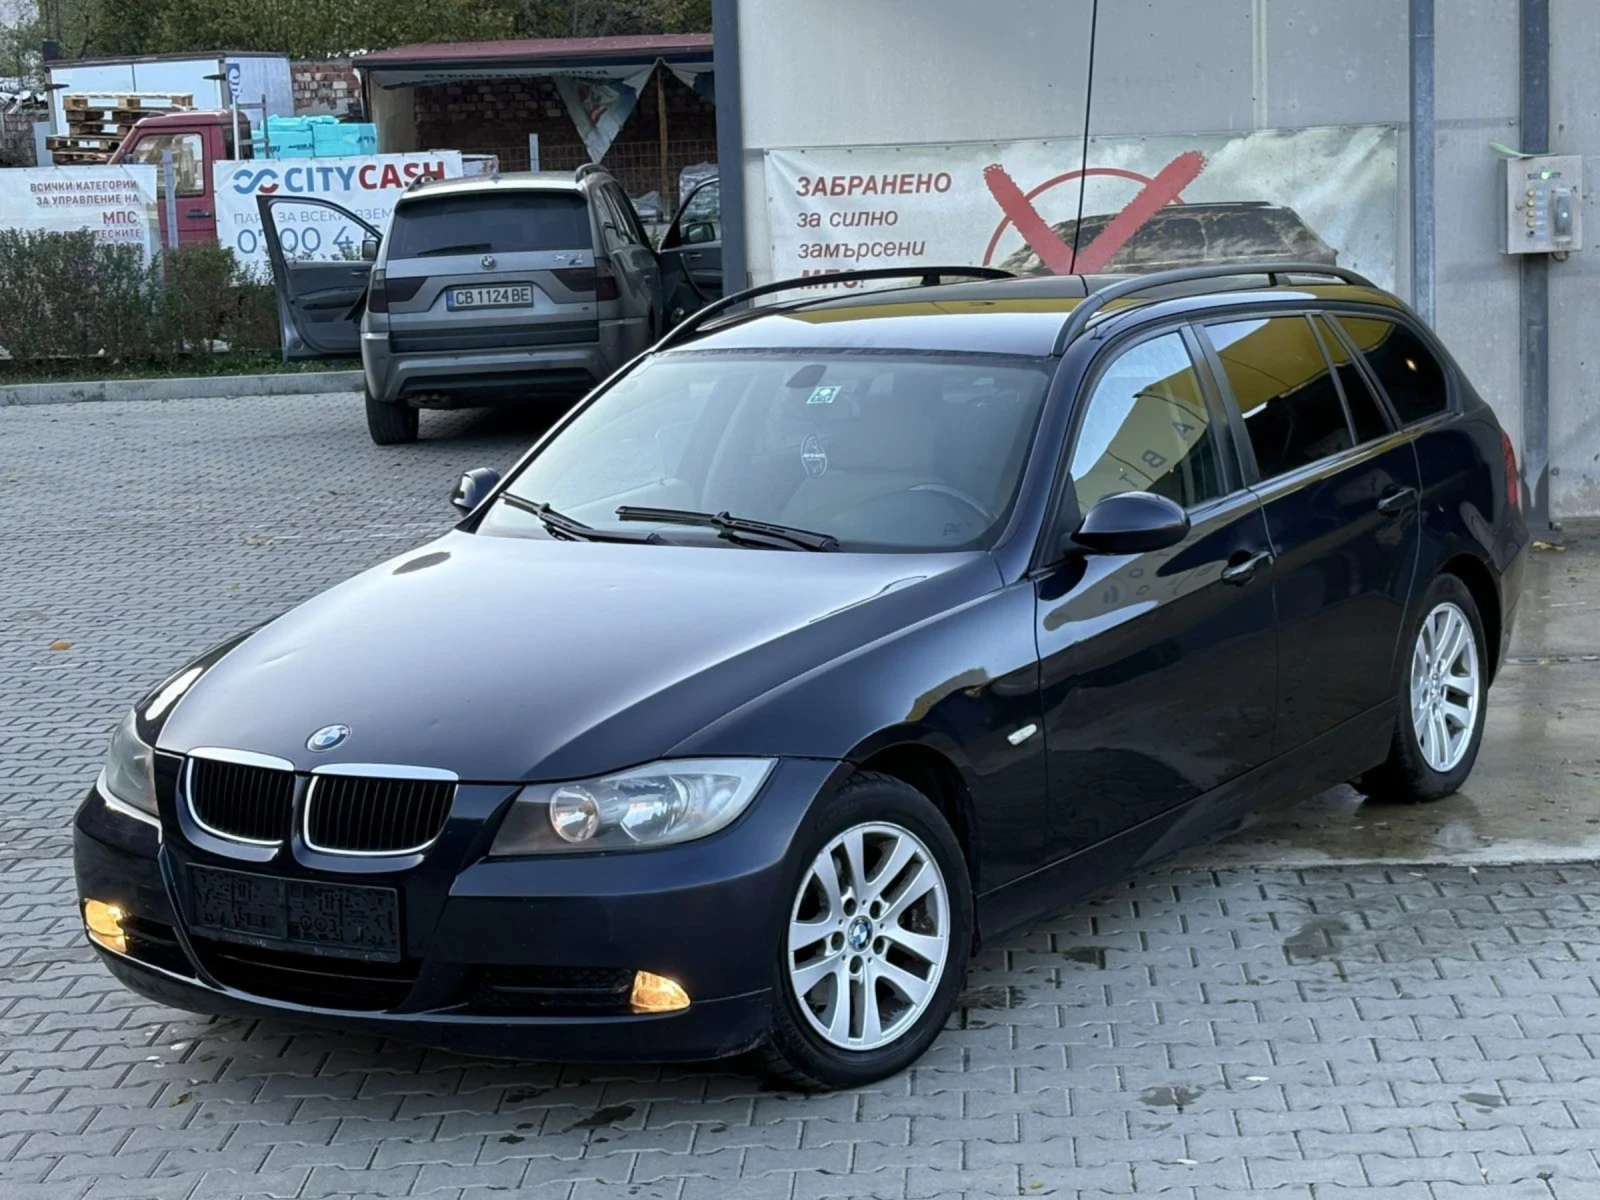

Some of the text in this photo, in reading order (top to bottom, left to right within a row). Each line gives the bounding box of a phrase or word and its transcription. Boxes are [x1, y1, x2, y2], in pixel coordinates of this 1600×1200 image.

[30, 180, 138, 193] ВСИЧКИ КАТЕГОРИИ
[796, 172, 952, 197] ЗАБРАНЕНО
[36, 194, 139, 206] ЗА УПРАВЛЕНИЕ НА
[103, 211, 138, 225] МПС
[234, 212, 260, 225] ПА
[278, 212, 297, 224] ЗА
[797, 210, 898, 228] за силно
[237, 226, 321, 254] 000
[798, 241, 925, 262] замърсени
[478, 289, 509, 304] 1124
